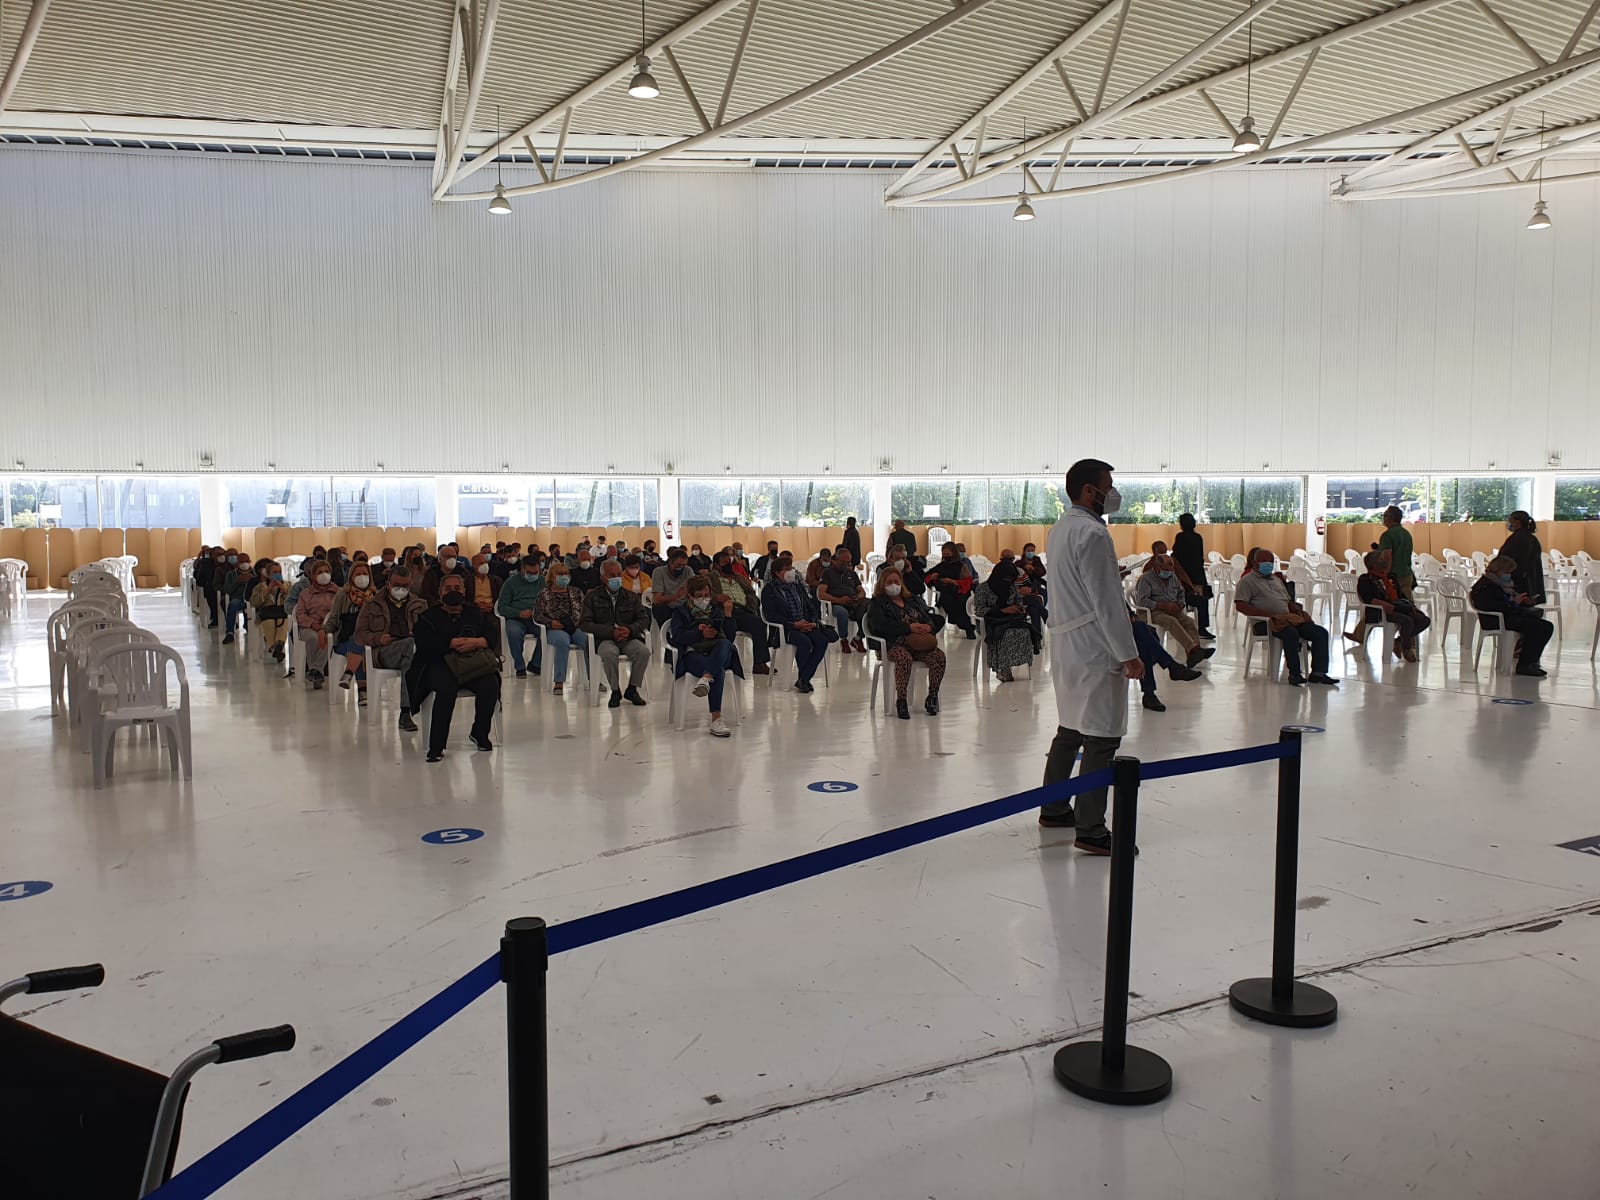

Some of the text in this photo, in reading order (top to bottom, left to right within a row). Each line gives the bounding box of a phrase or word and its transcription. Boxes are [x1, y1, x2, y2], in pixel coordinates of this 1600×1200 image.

[823, 782, 848, 791] 6
[440, 829, 469, 842] 5
[0, 883, 30, 897] 4
